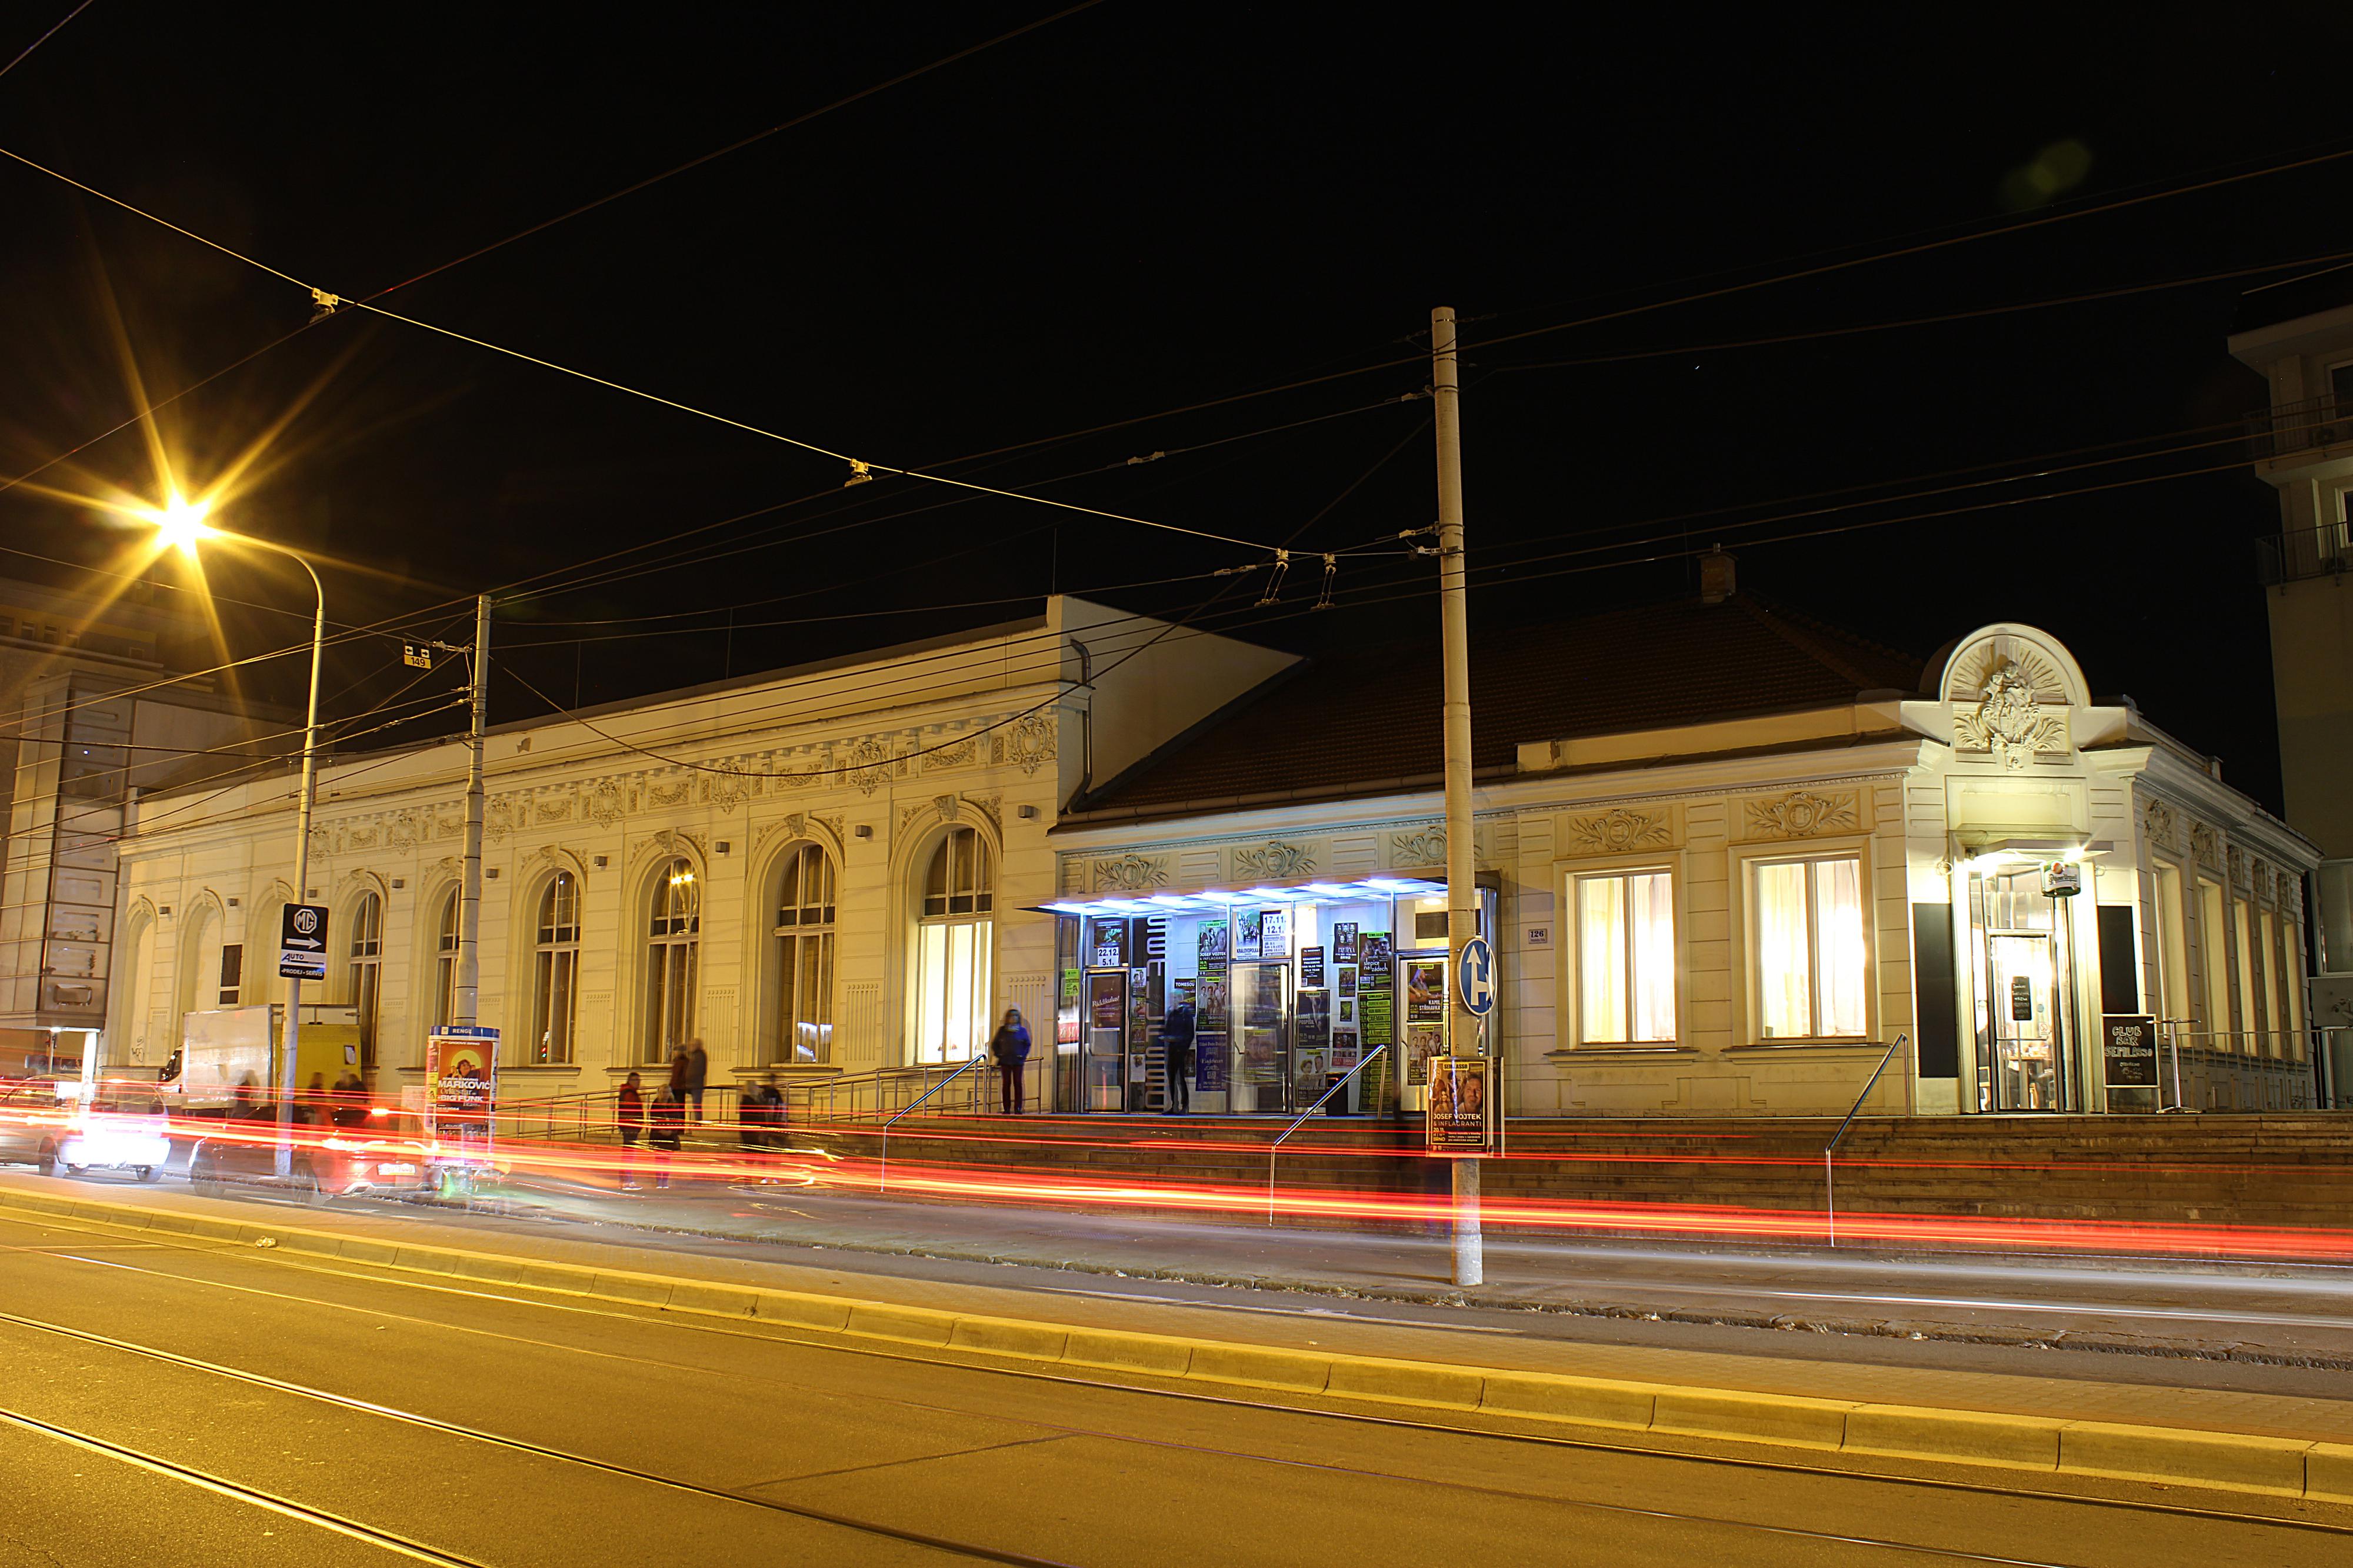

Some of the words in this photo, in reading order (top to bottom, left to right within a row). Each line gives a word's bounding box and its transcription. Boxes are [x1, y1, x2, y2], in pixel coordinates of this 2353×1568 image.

[411, 657, 425, 667] 149
[1265, 916, 1287, 924] 17.11.
[1098, 948, 1119, 956] 22.12.
[1364, 958, 1380, 968] slepice
[1371, 962, 1388, 972] zádech
[2112, 1026, 2142, 1036] CLUB
[2116, 1036, 2139, 1046] BAR
[2104, 1046, 2153, 1057] SEMILASSO
[438, 1080, 490, 1090] MARKOVIĆ
